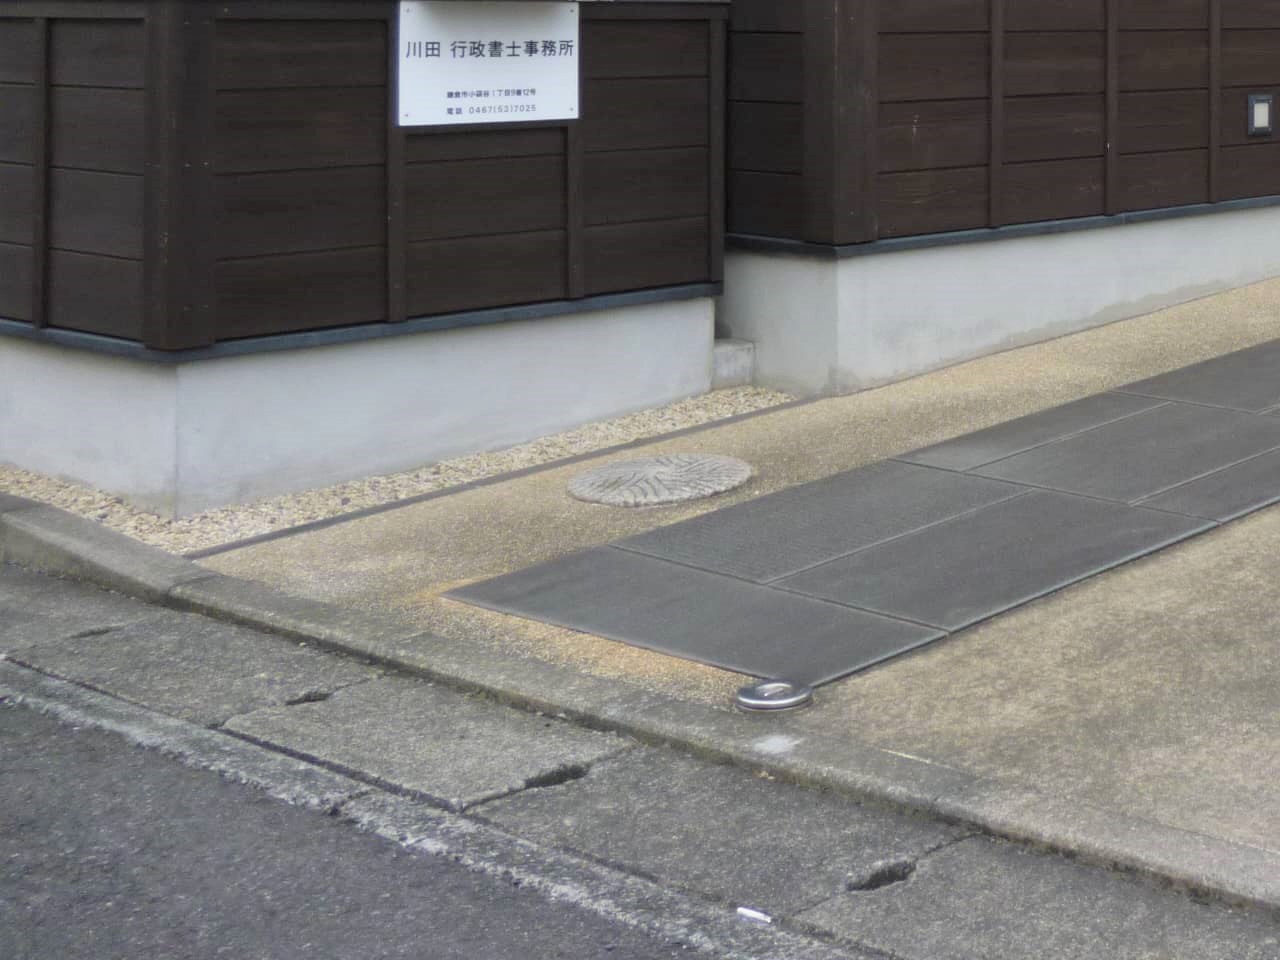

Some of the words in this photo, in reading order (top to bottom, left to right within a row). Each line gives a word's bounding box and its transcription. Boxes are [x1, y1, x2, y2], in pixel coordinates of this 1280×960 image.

[406, 40, 441, 58] 川田
[450, 40, 574, 58] 行政書士事務所
